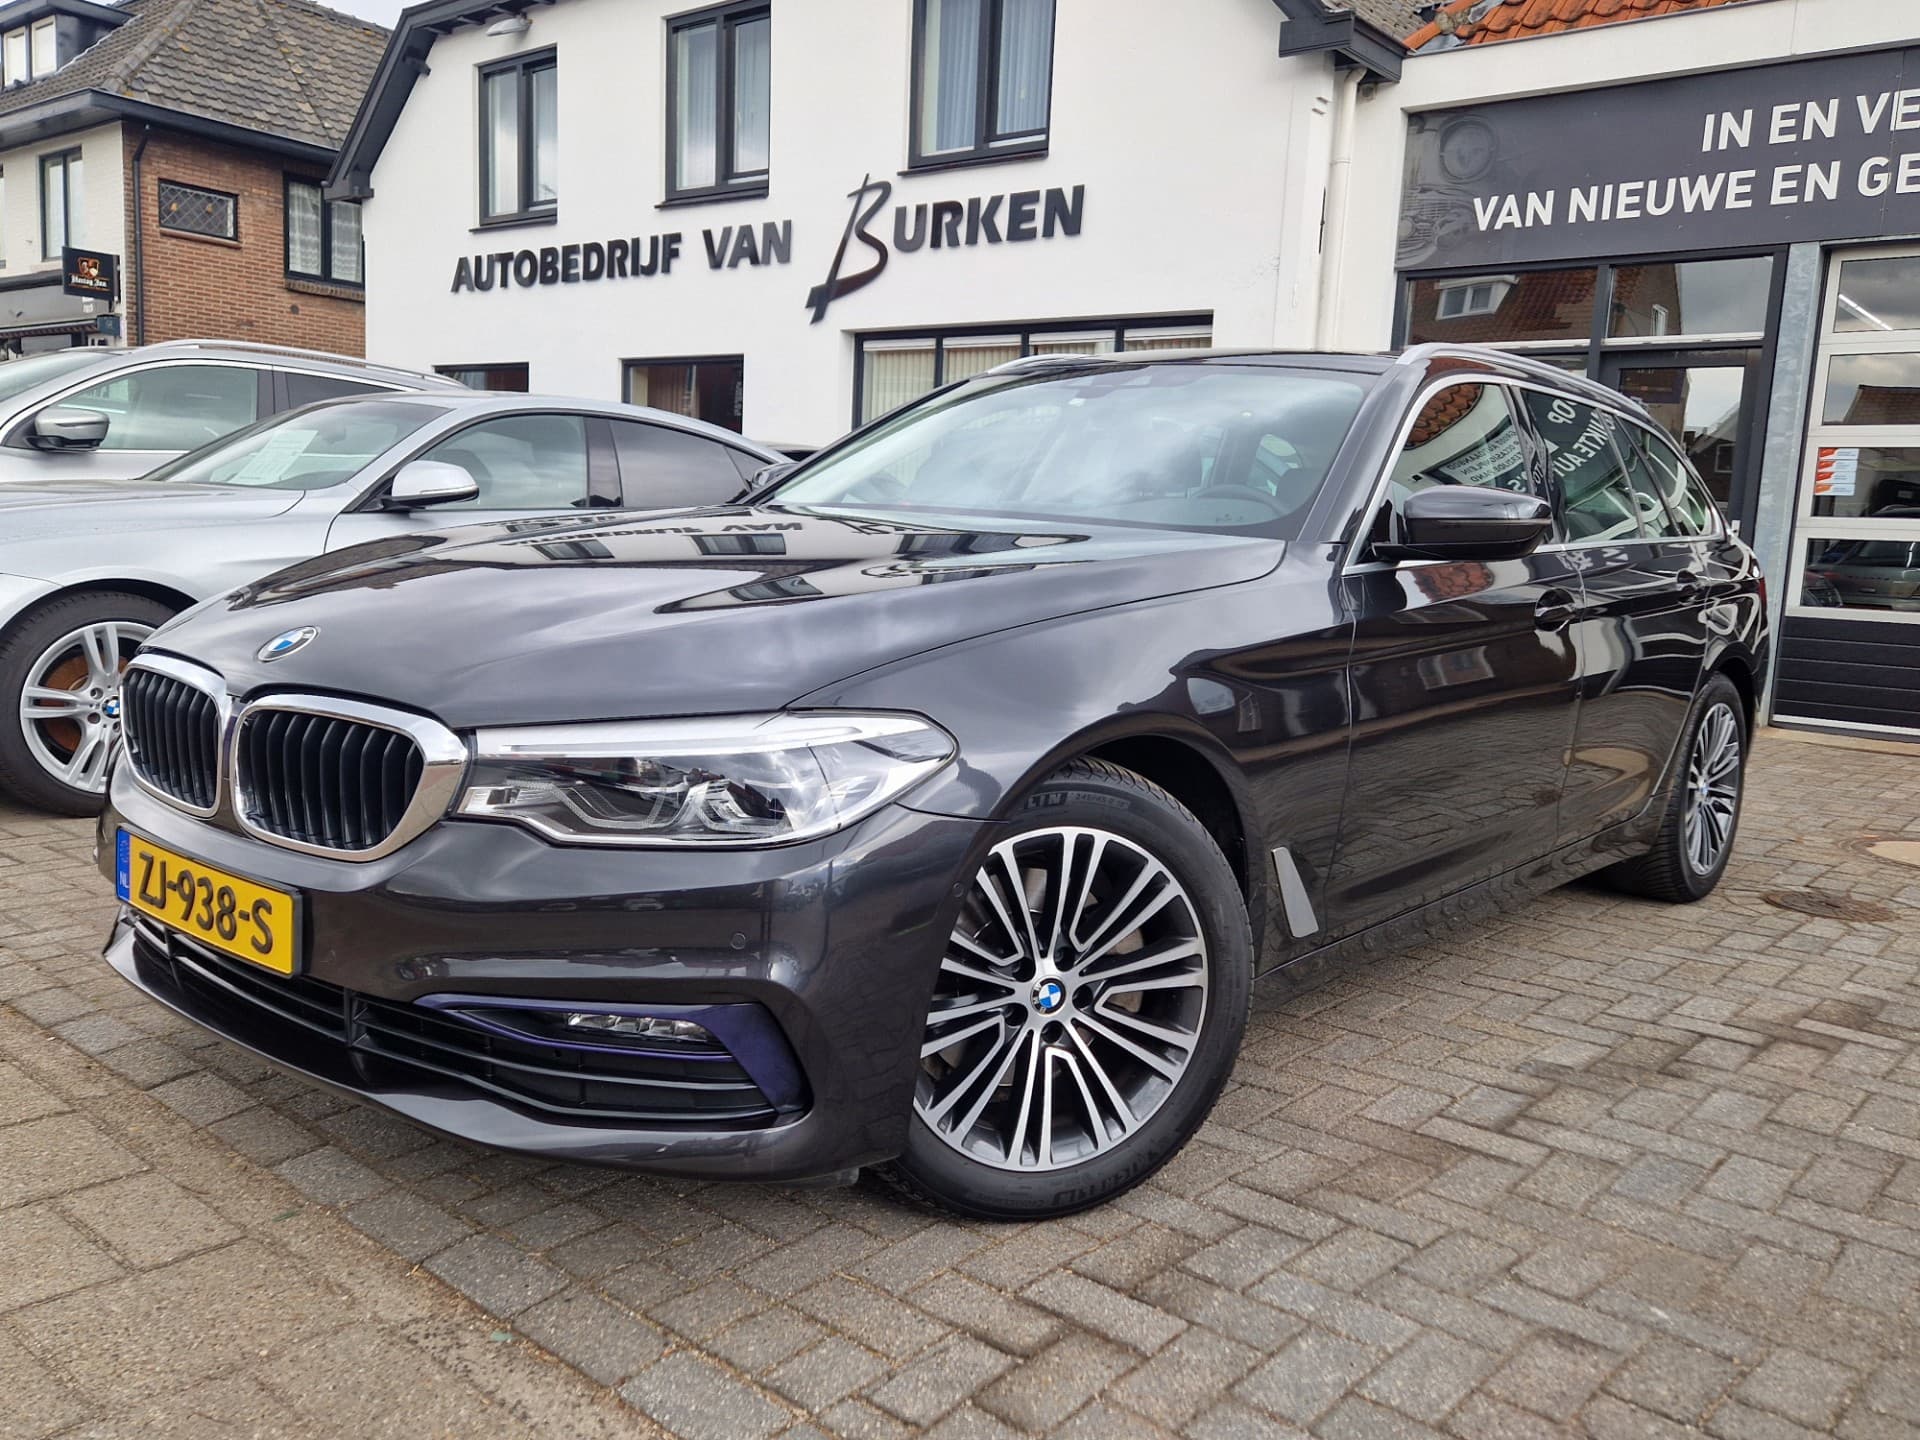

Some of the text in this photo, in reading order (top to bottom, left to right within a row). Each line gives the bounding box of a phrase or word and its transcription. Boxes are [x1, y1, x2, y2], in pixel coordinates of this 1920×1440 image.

[1702, 109, 1753, 152] IN
[1769, 98, 1840, 144] EN
[1473, 190, 1554, 231] VAN
[1567, 169, 1756, 224] NIEUWE
[1770, 160, 1841, 206] EN
[450, 231, 682, 293] AUTOBEDRIJF
[702, 219, 792, 270] VAN
[119, 871, 129, 889] NL
[139, 851, 273, 955] ZJ-938-S
